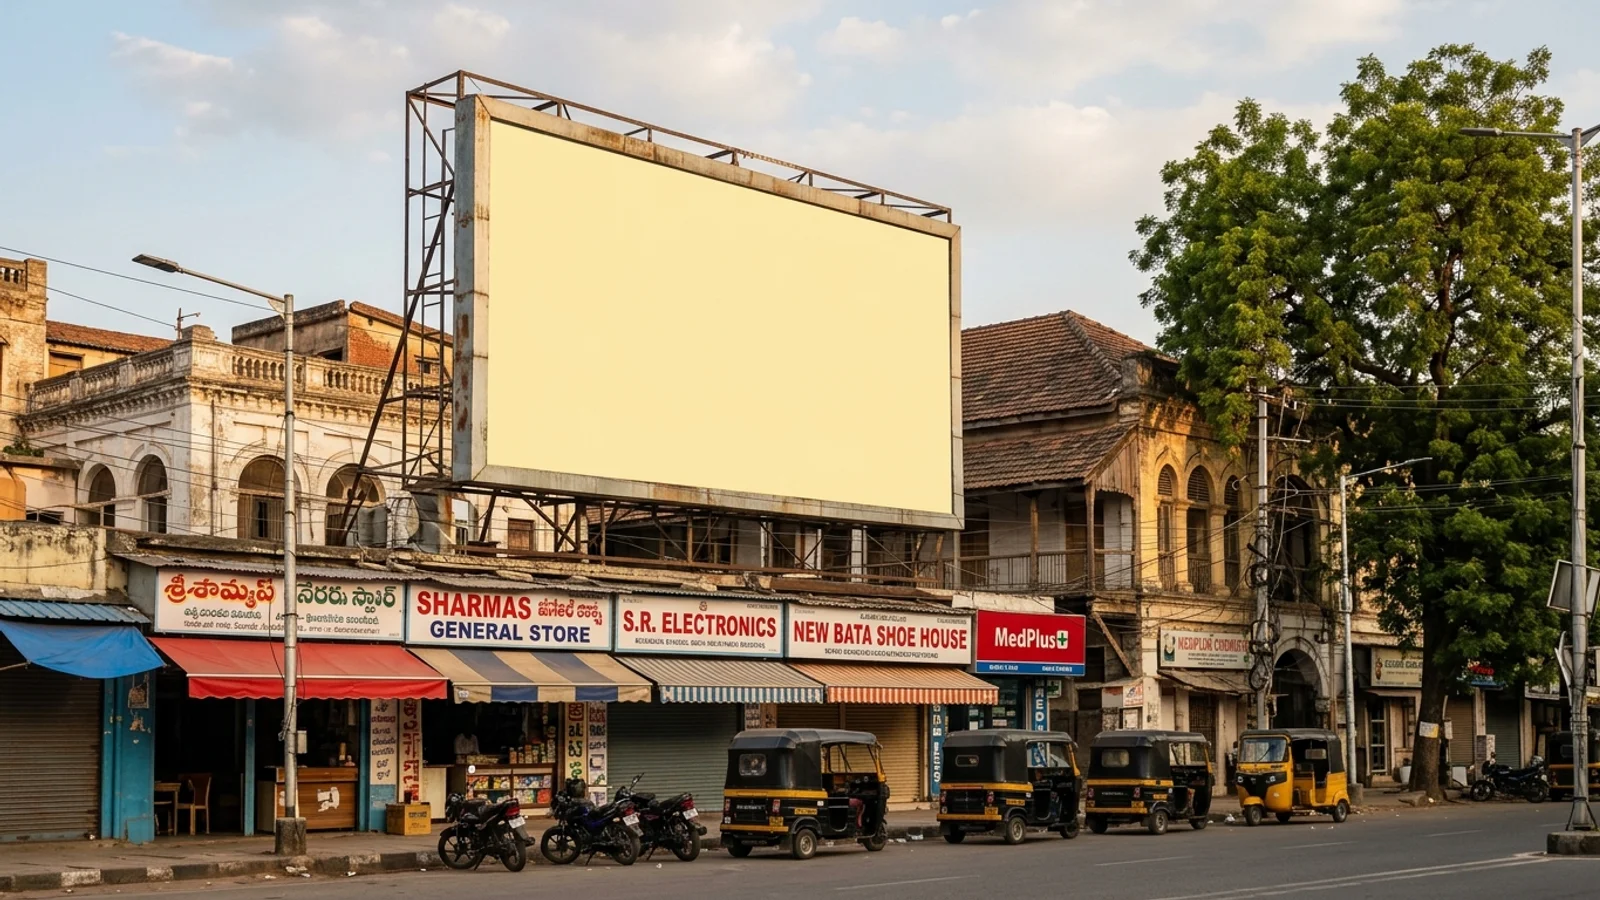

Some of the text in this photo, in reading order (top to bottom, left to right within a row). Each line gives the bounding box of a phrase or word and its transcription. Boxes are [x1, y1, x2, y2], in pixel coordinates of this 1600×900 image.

[416, 591, 531, 620] SHARMAS
[430, 620, 590, 643] GENERAL STORE
[623, 610, 776, 638] S.R. ELECTRONICS
[793, 620, 829, 643] NEW
[833, 622, 873, 645] BATA
[876, 625, 916, 648] SHOE
[919, 628, 967, 650] HOUSE
[994, 627, 1057, 649] MedPlus
